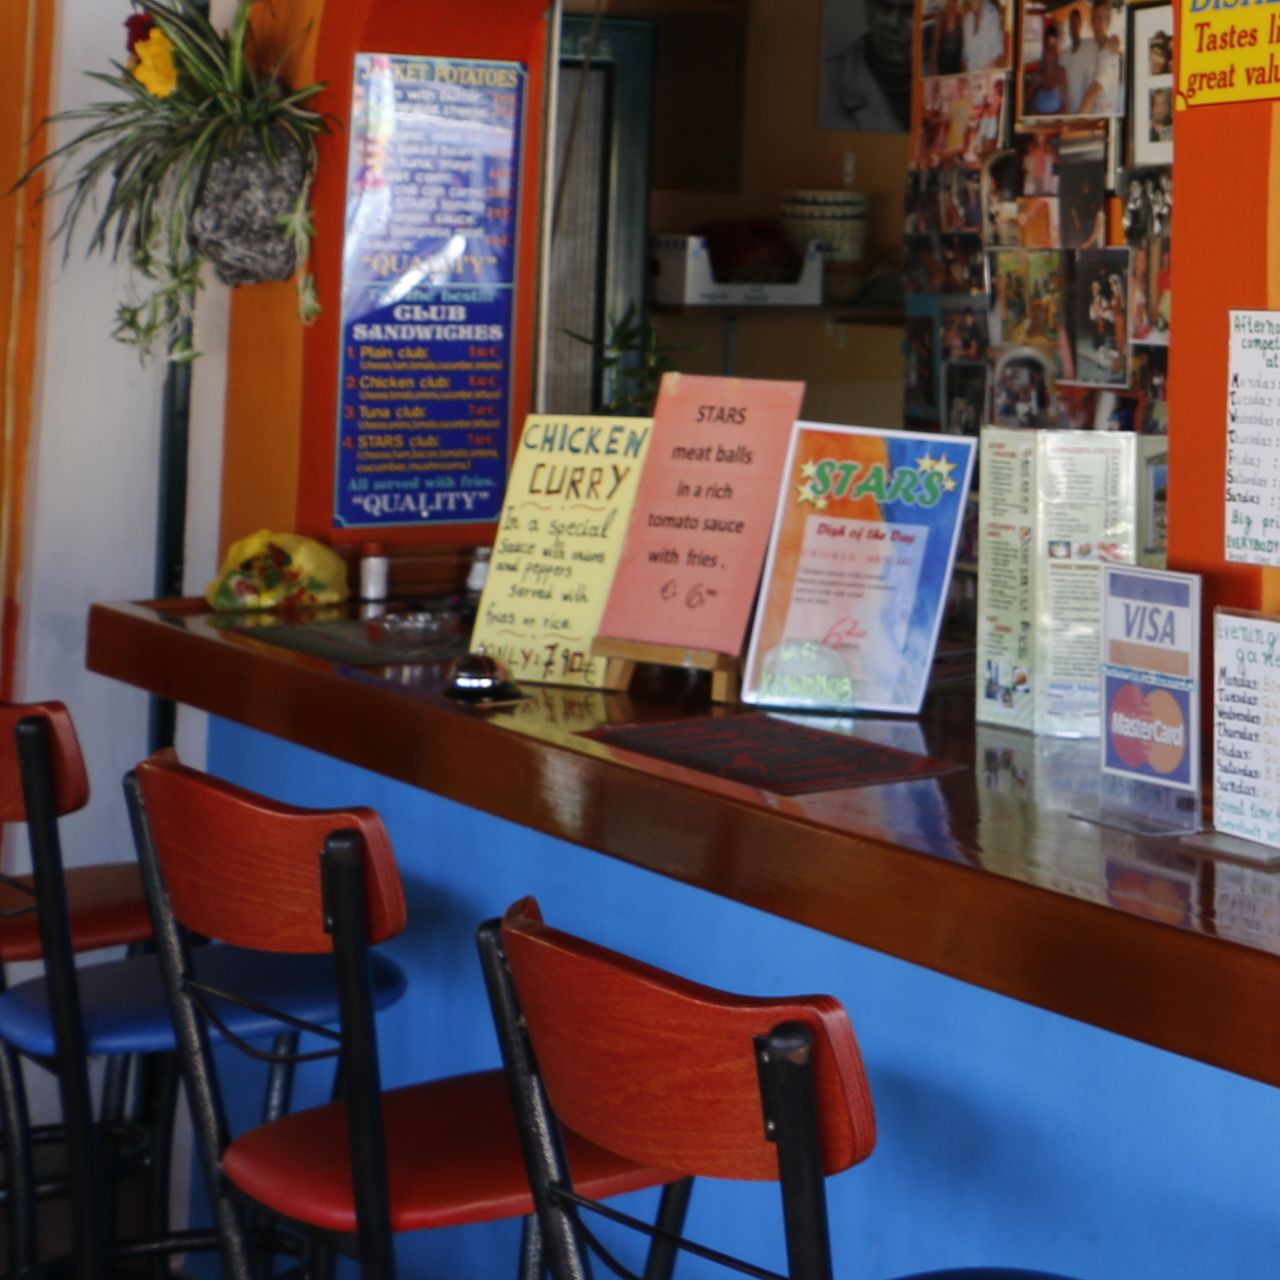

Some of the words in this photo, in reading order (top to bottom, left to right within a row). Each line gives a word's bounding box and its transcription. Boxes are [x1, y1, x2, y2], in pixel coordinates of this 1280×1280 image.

[1194, 22, 1258, 53] Tastes
[1187, 64, 1235, 98] great
[393, 305, 466, 321] CLUB
[353, 324, 503, 340] SANDWICHES
[360, 346, 393, 358] Plain
[1266, 354, 1278, 369] at
[360, 376, 415, 388] Chicken
[360, 406, 390, 418] Tuna
[697, 405, 747, 424] STARS
[359, 436, 403, 448] STARS
[523, 424, 651, 459] CHICKEN
[672, 446, 711, 462] meat
[715, 446, 752, 465] balls
[349, 478, 368, 491] All
[529, 463, 631, 500] CURRY
[677, 483, 691, 497] in
[694, 486, 702, 497] a
[706, 485, 732, 499] rich
[811, 459, 944, 506] STARS
[502, 506, 518, 530] In
[528, 520, 538, 531] a
[648, 514, 698, 530] tomato
[702, 518, 744, 533] sauce
[648, 548, 679, 564] with
[1124, 603, 1175, 646] VISA
[1111, 712, 1184, 747] MasterCard
